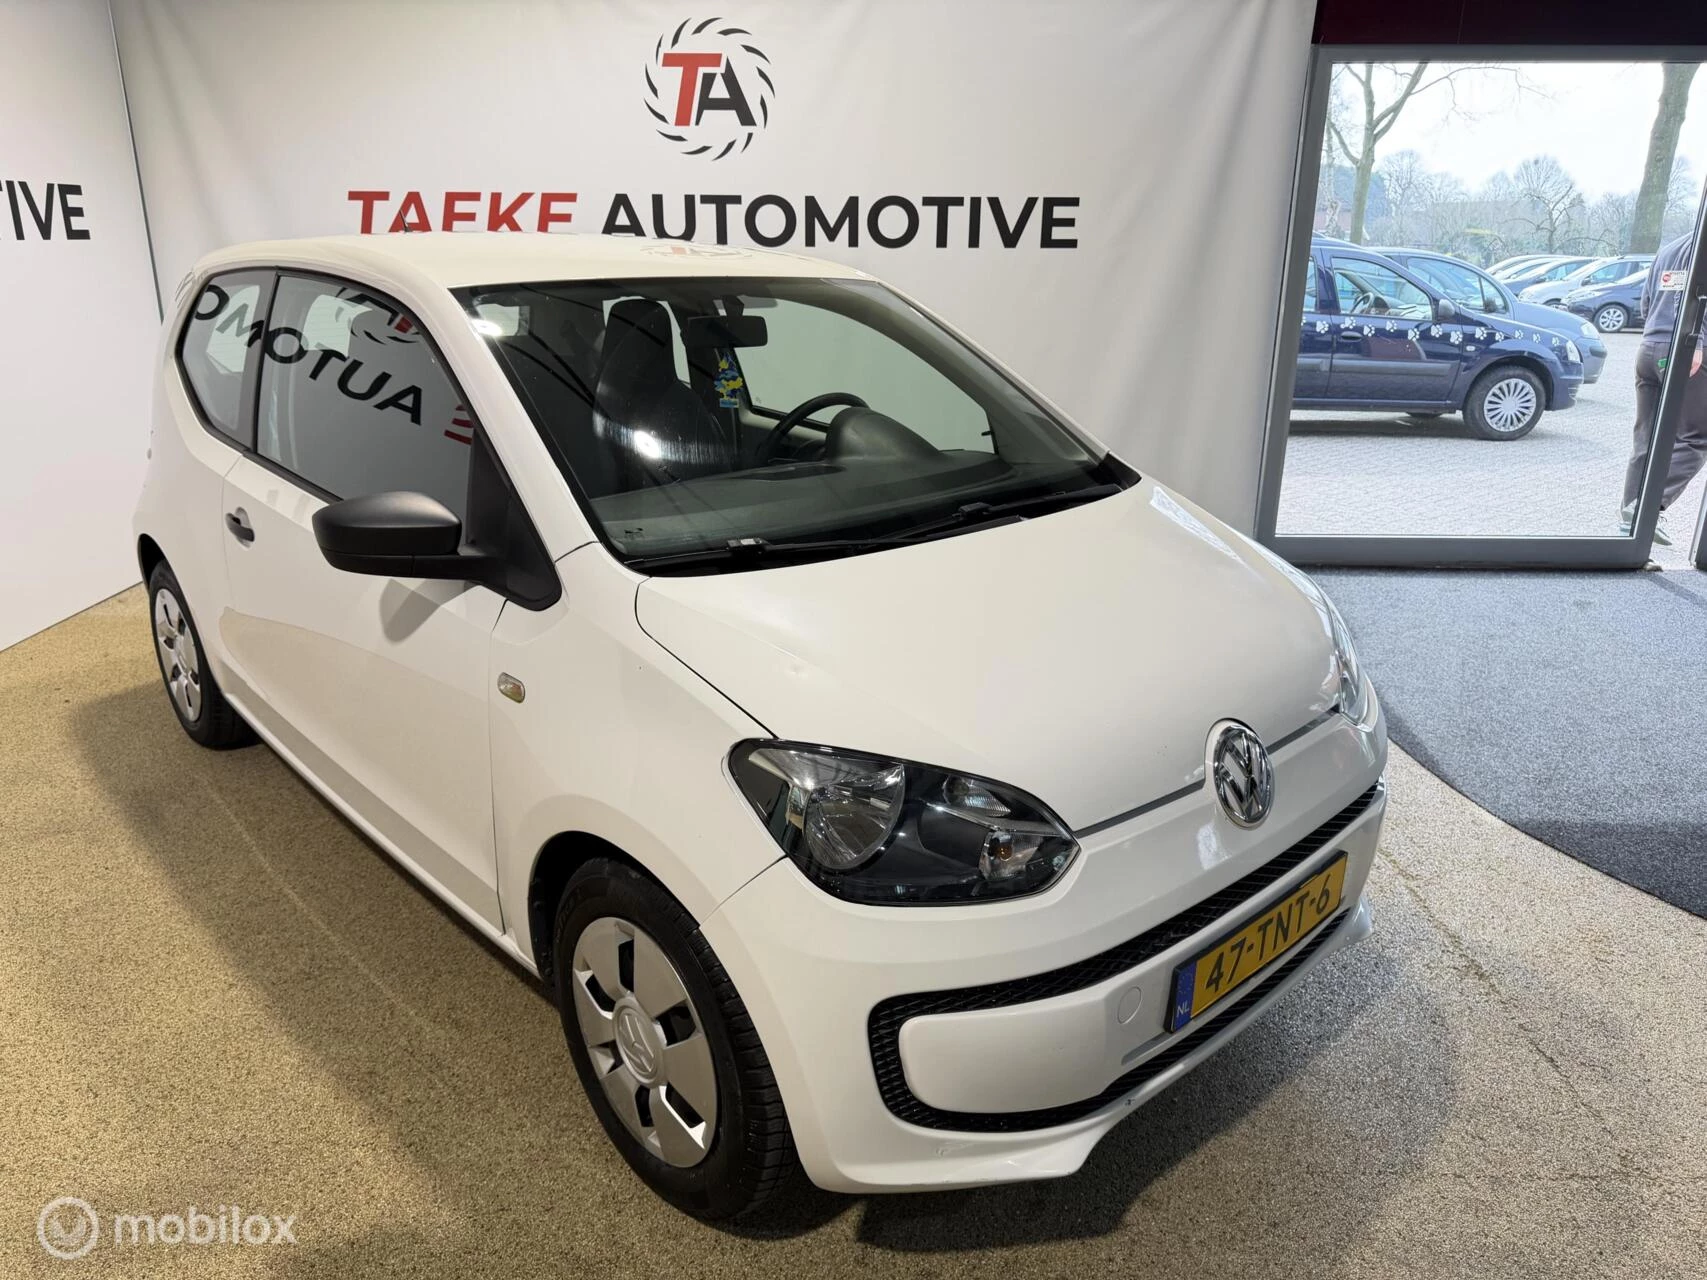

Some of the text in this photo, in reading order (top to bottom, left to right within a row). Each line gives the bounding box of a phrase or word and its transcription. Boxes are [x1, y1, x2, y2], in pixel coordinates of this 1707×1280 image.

[661, 53, 757, 126] TA
[0, 180, 91, 240] IVE
[601, 194, 1080, 249] AUTOMOTIVE
[1205, 874, 1331, 993] 47-TNT-6
[1176, 1004, 1190, 1018] NL
